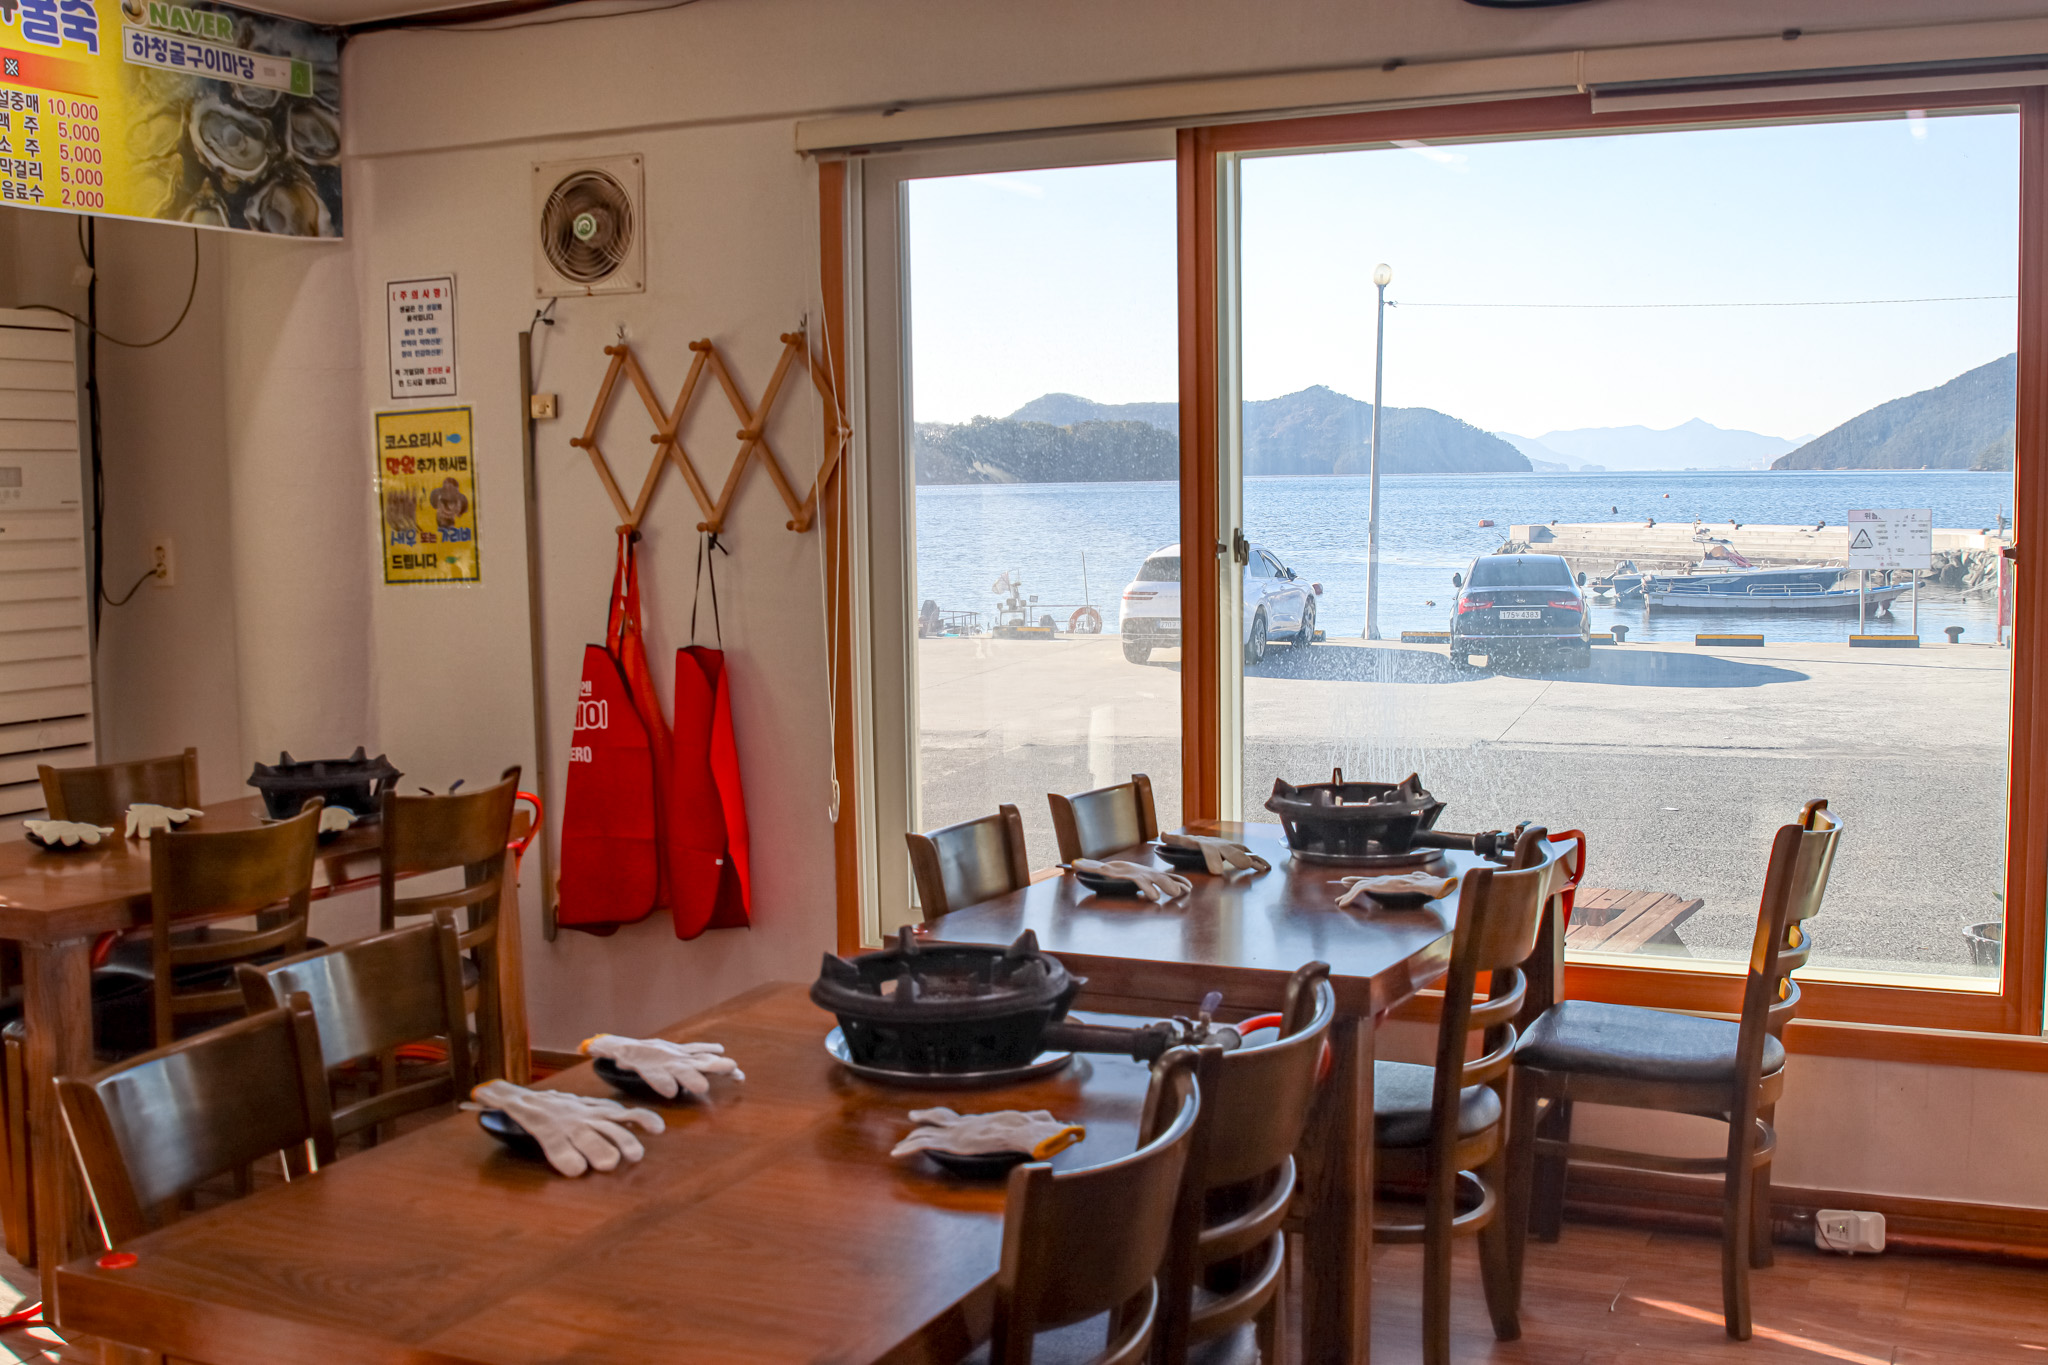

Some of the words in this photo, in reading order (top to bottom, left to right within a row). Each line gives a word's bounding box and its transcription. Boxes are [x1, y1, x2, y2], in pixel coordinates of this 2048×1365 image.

[150, 2, 233, 41] NAVER
[132, 33, 254, 80] 하청굴구이마당
[48, 98, 99, 121] 10,000
[58, 121, 100, 143] 5,000
[60, 144, 102, 165] 5,000
[0, 158, 43, 181] 막걸리
[61, 166, 103, 187] 5,000
[1, 180, 45, 203] 음료수
[62, 188, 104, 209] 2,000
[385, 432, 443, 449] 코스요리시
[390, 528, 417, 547] 새우
[437, 527, 472, 543] 가리비
[392, 553, 438, 569] 드립니다
[570, 745, 592, 763] ERO
